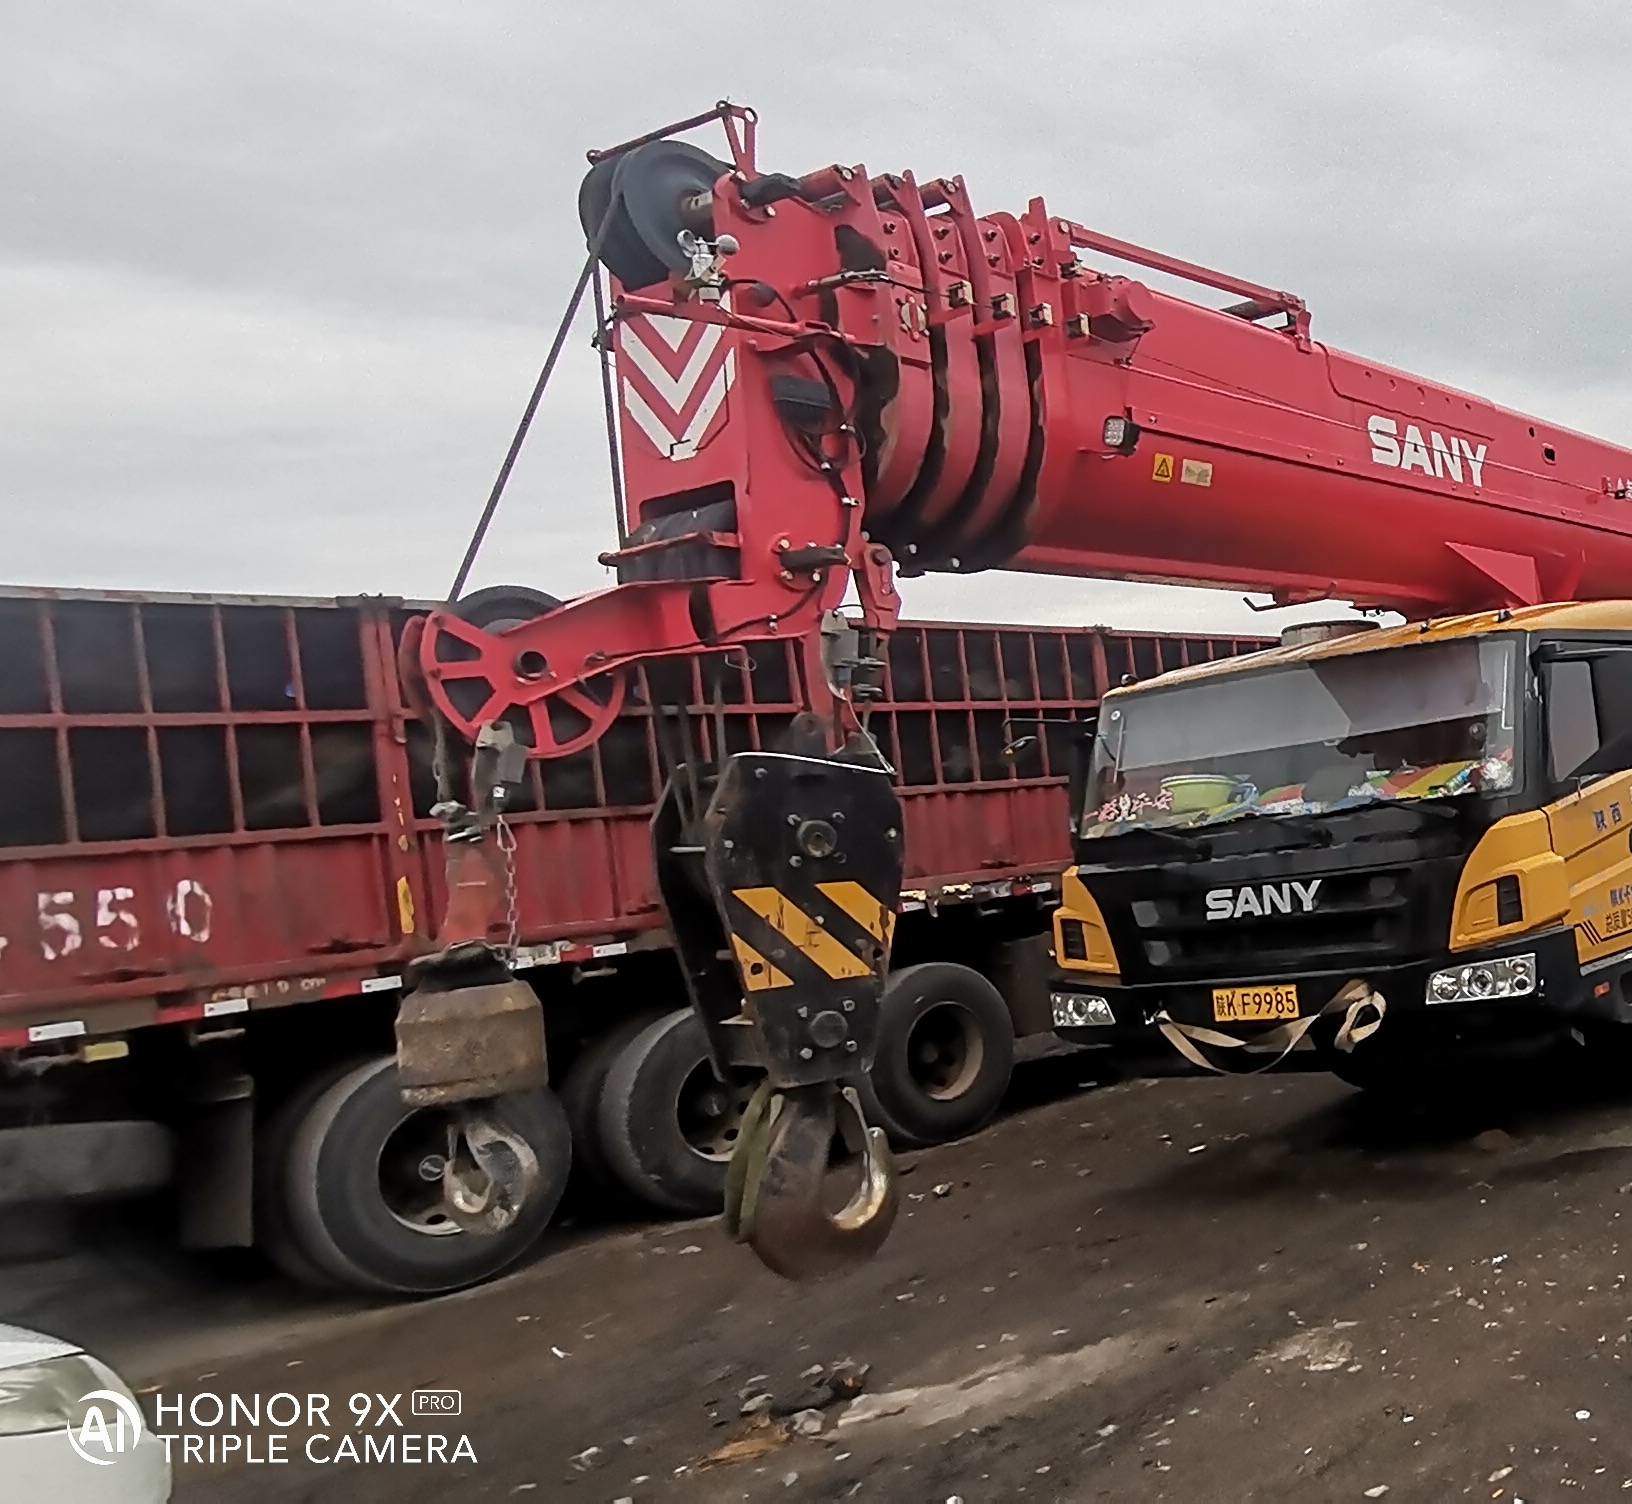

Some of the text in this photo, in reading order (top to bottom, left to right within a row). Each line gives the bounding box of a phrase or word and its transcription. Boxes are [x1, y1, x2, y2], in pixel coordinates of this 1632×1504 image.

[1367, 414, 1487, 488] SANY
[0, 879, 212, 960] 550
[1205, 879, 1322, 921] SANY
